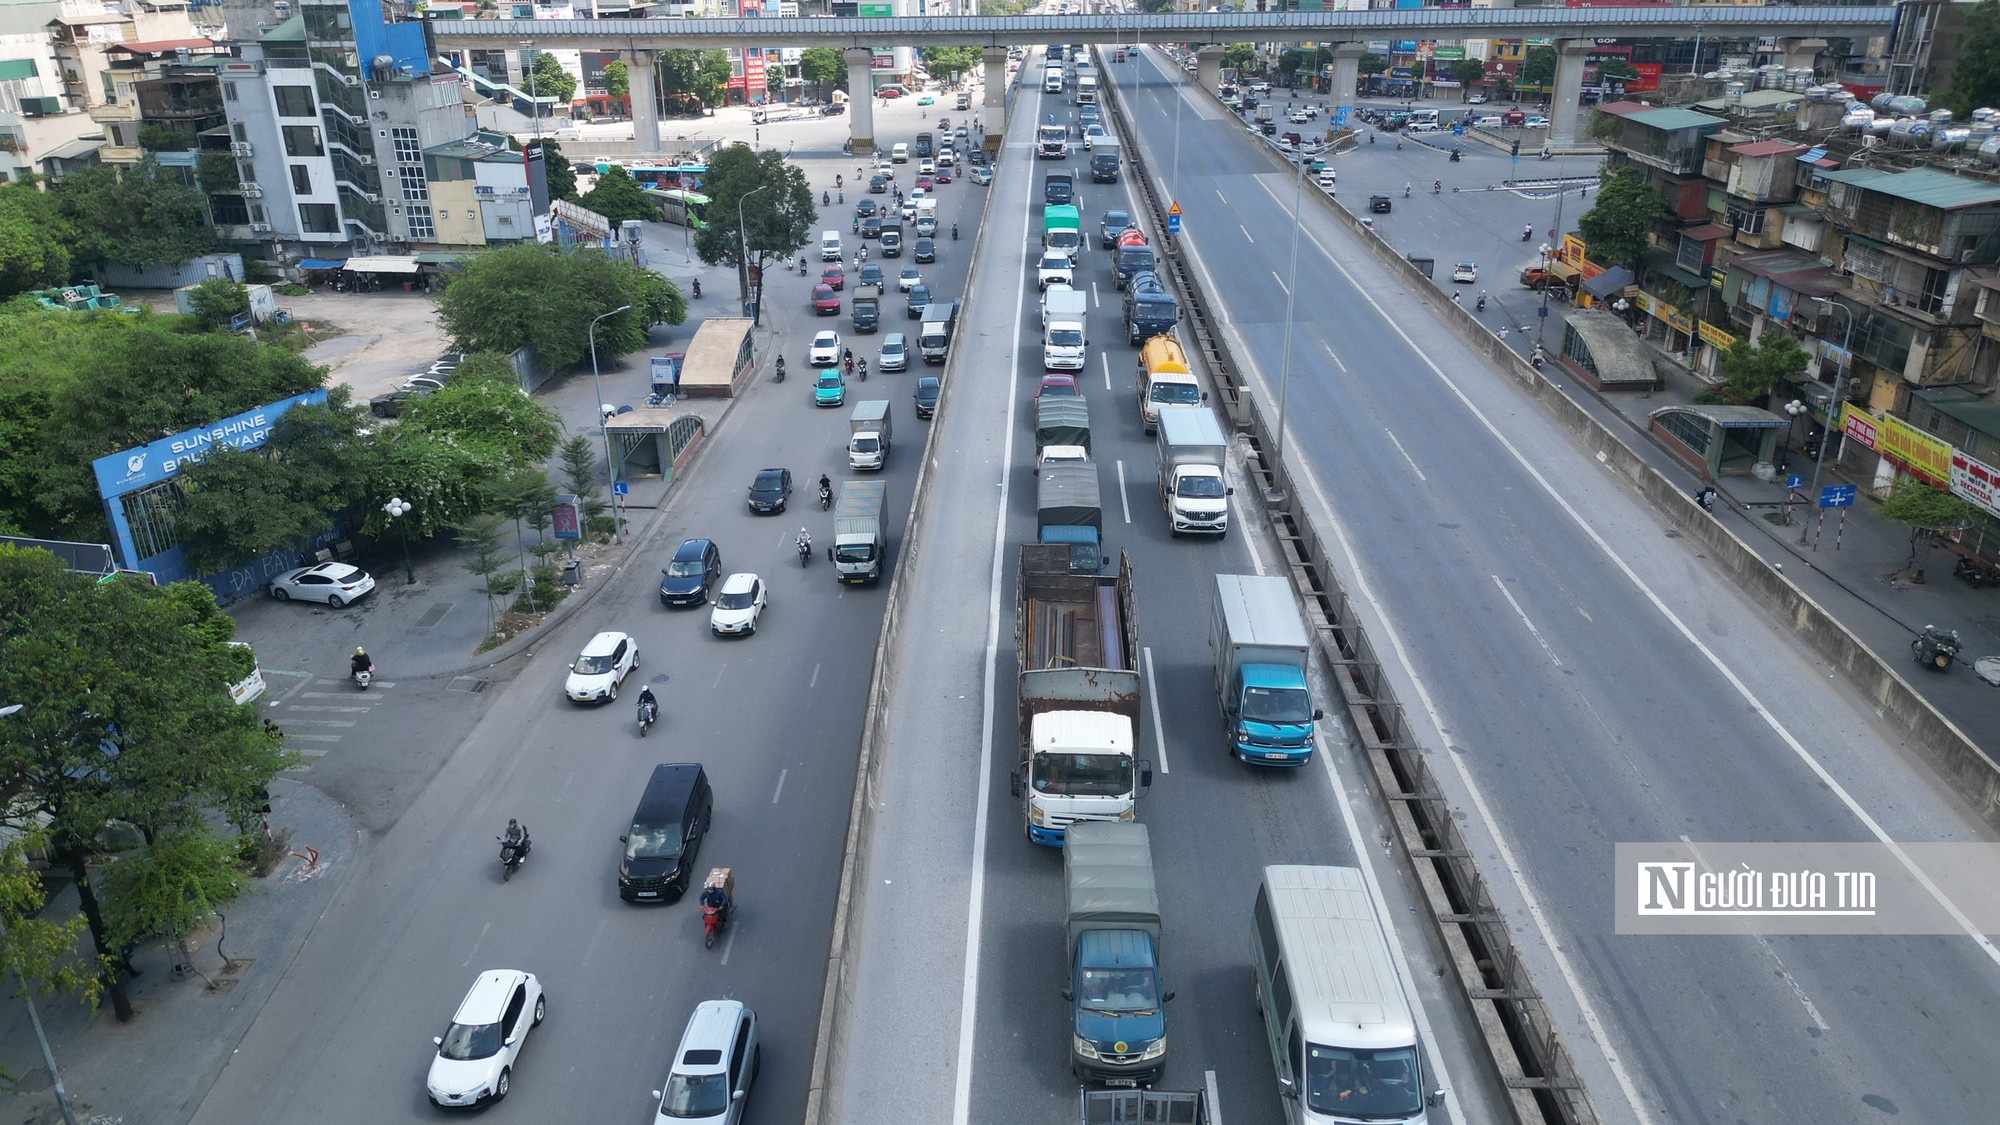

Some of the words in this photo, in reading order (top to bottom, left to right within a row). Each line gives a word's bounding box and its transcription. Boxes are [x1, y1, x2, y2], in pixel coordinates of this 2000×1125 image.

[162, 426, 275, 473] BOUEVAR
[171, 414, 266, 454] SUNSHINE
[1960, 480, 1993, 503] HONDA
